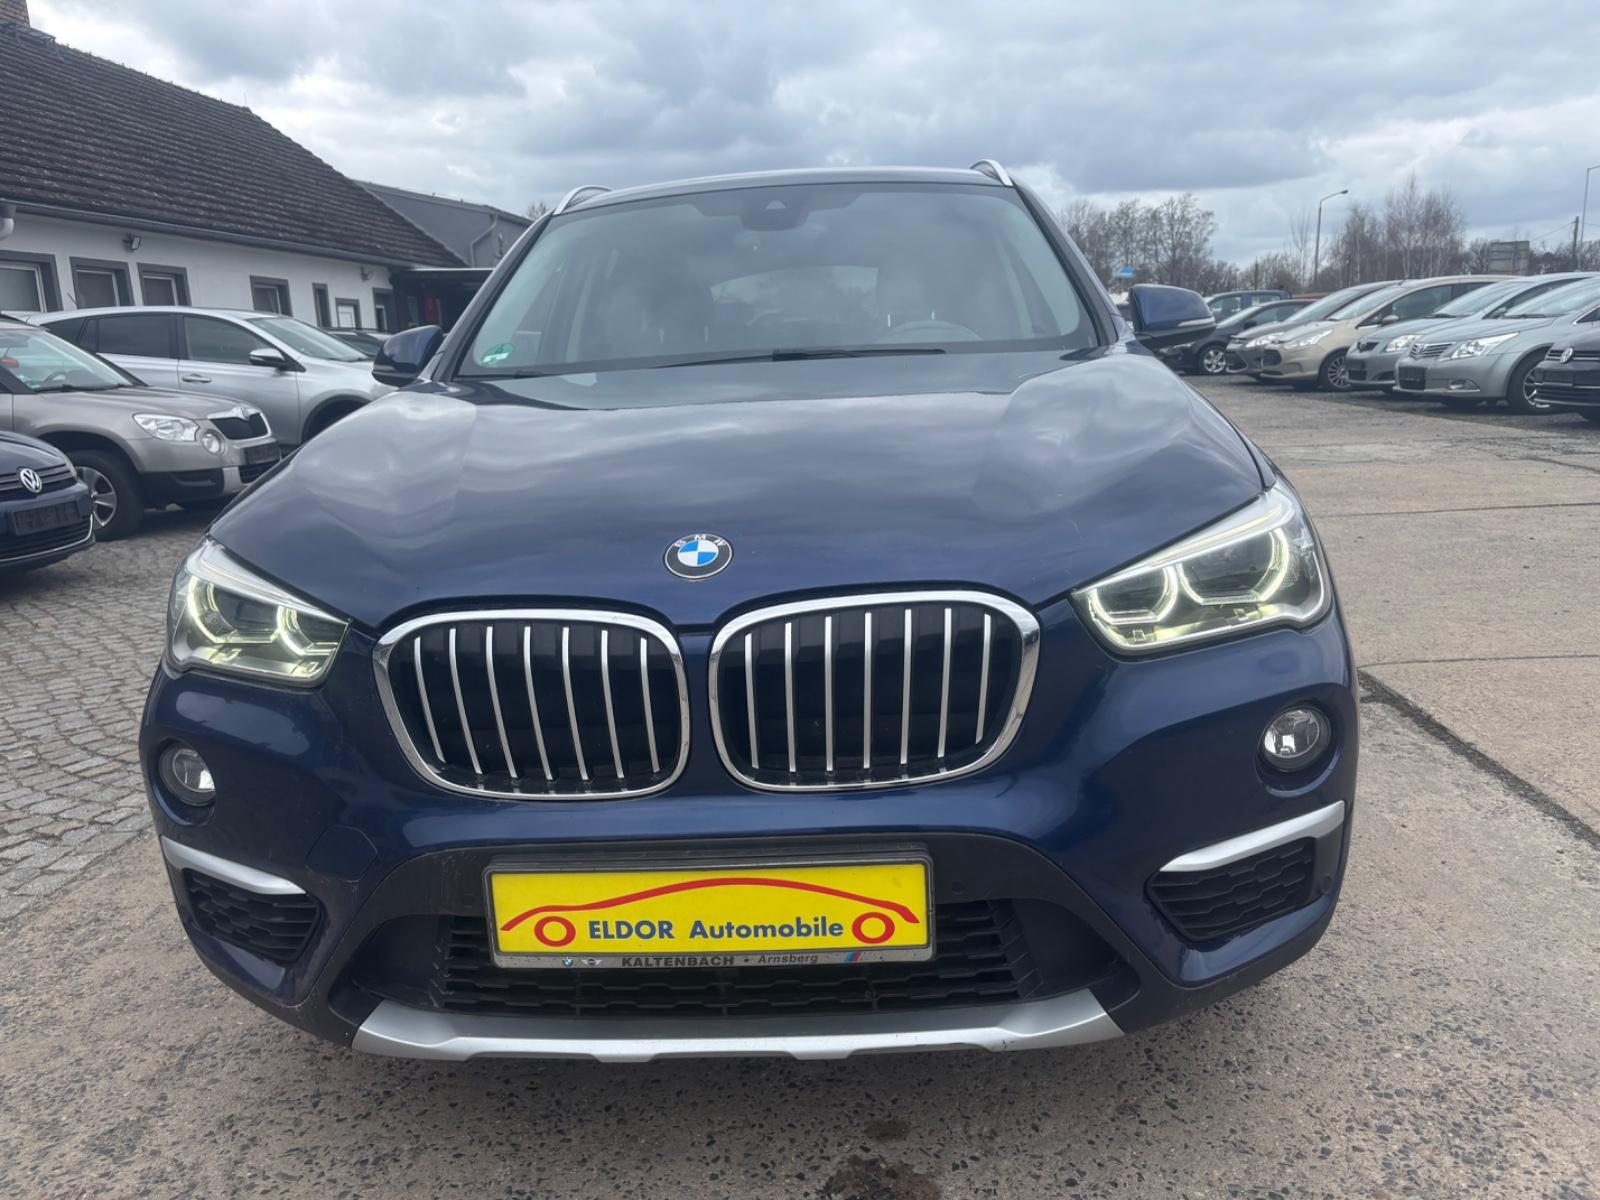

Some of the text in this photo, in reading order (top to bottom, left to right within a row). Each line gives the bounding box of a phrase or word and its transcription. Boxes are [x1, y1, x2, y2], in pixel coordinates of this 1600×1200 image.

[588, 916, 845, 940] ELDOR Automobile
[621, 954, 818, 967] KALTENBACH Arnsberg
